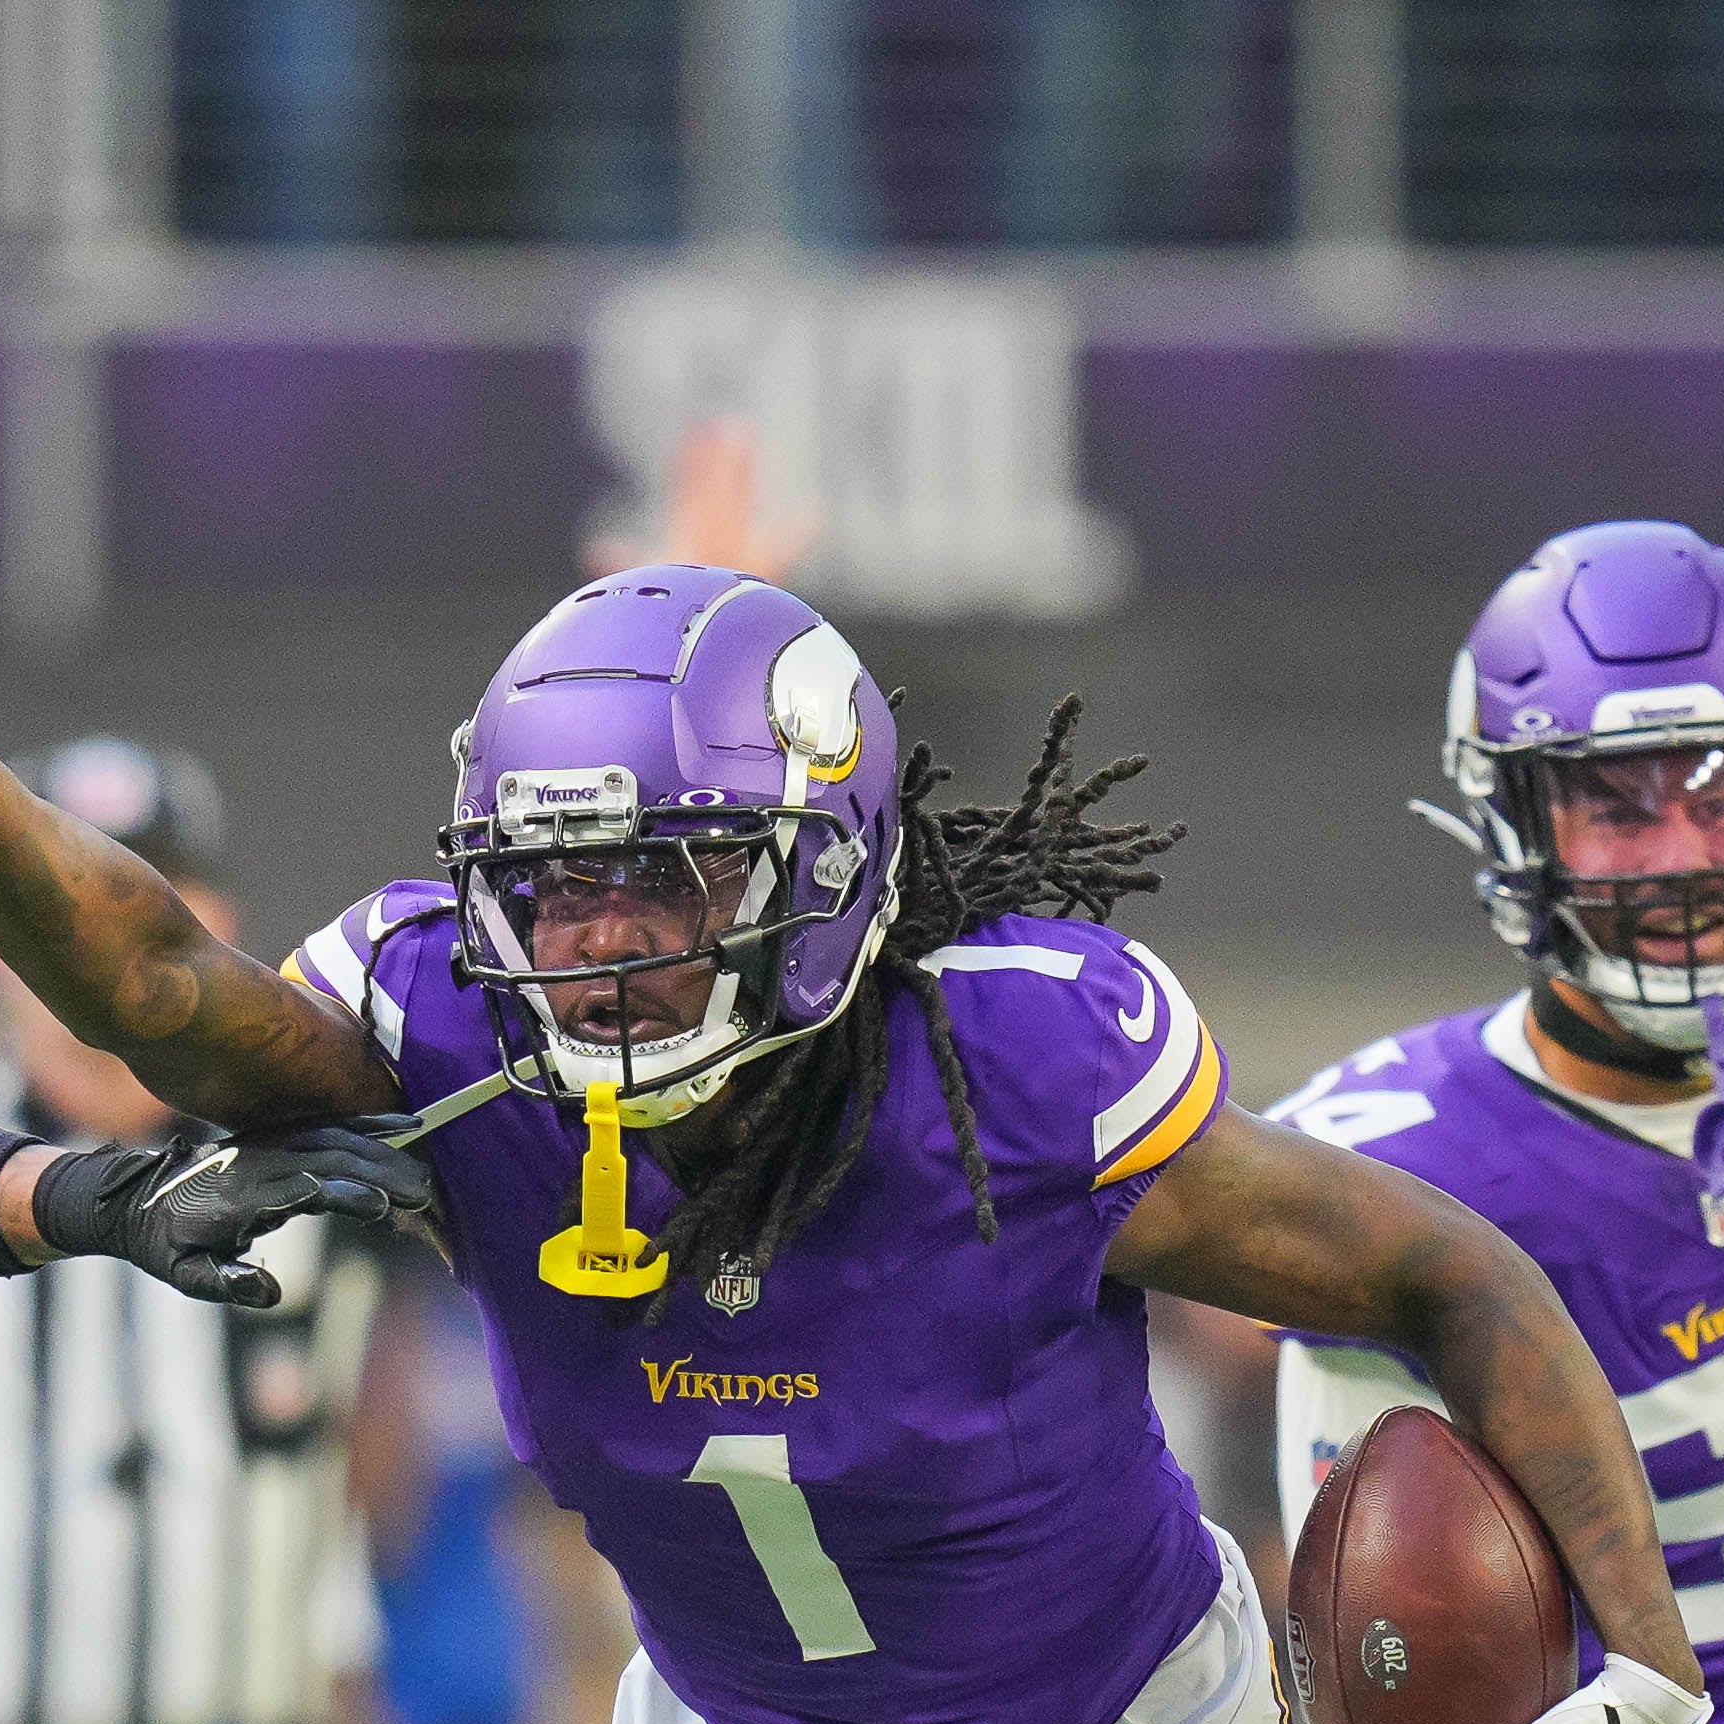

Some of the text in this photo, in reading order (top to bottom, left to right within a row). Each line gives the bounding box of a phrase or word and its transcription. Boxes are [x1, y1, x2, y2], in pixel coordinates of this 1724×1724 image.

[715, 1278, 750, 1303] NFL
[640, 1353, 820, 1407] VIKINGS
[682, 1434, 877, 1662] 1
